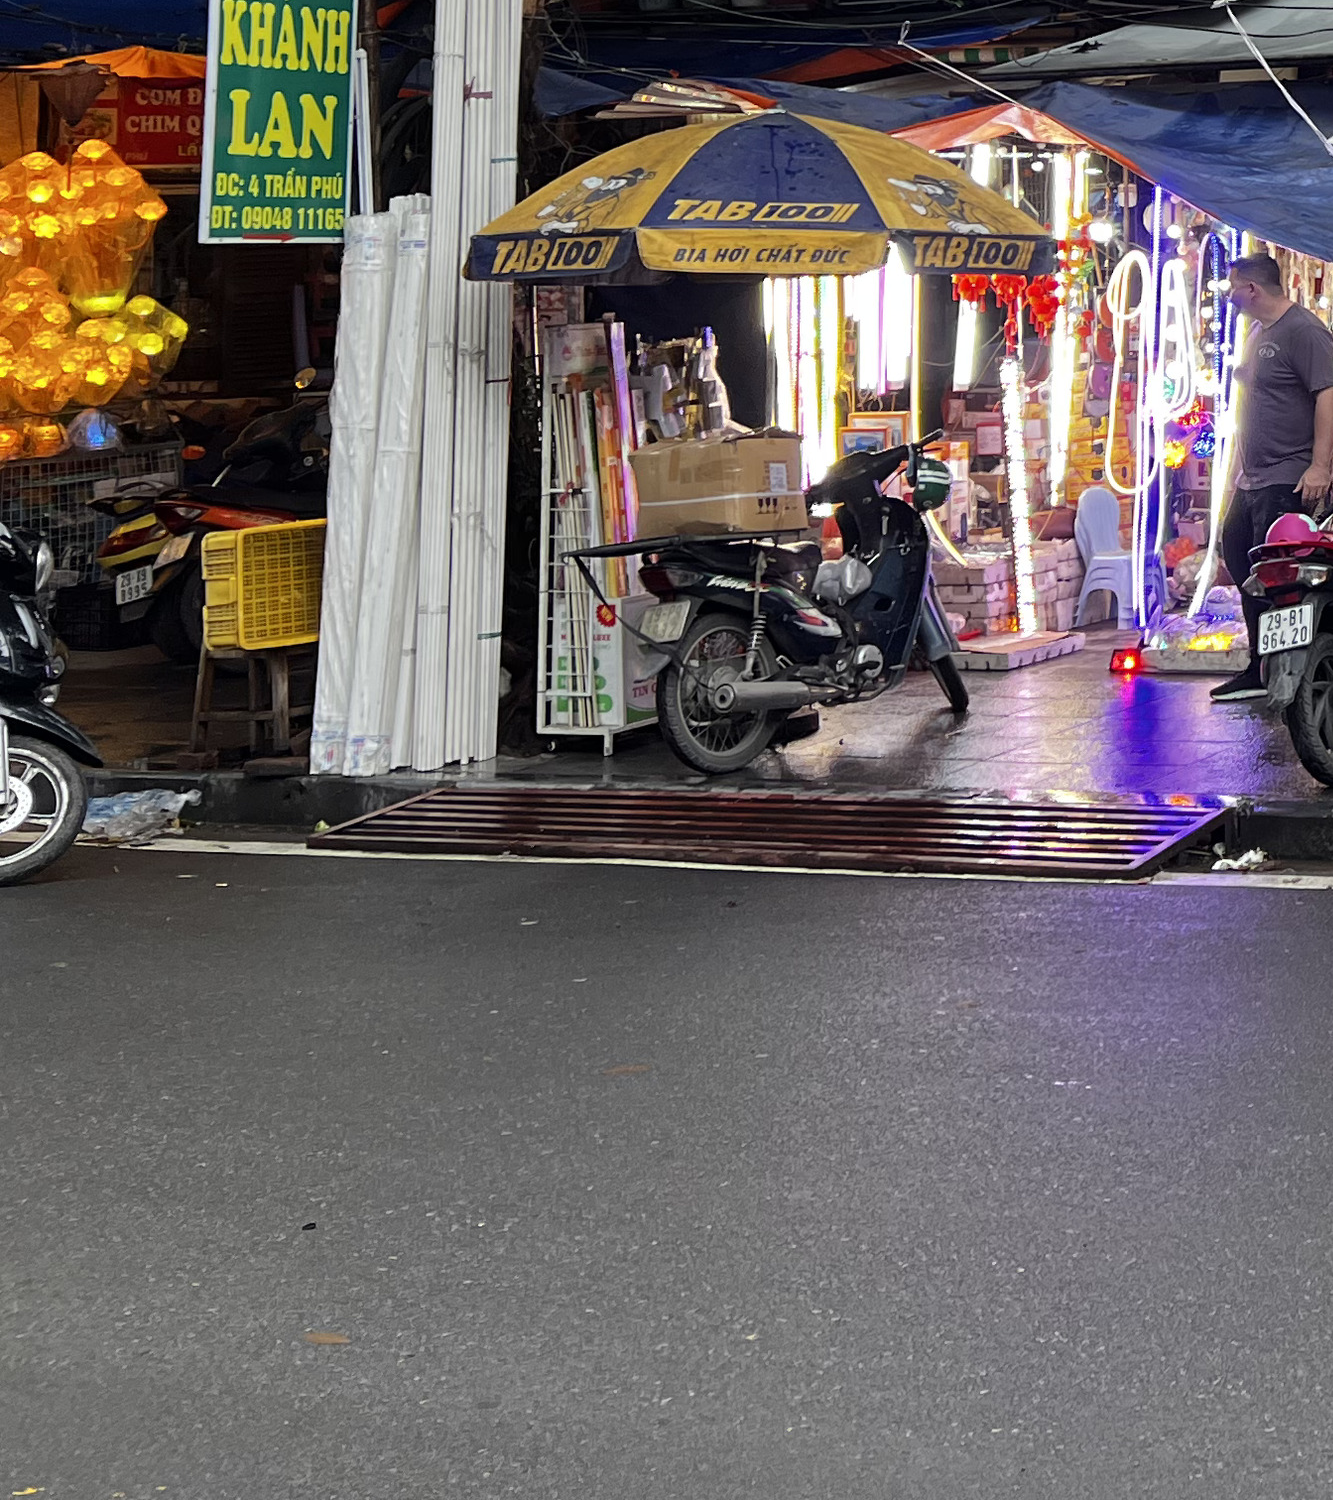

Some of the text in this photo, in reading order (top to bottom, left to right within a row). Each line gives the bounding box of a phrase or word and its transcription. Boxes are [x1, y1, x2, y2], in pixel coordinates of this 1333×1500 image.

[125, 115, 180, 133] CHIM
[227, 88, 338, 160] LAN
[215, 172, 244, 197] ĐC:
[248, 174, 259, 198] 4
[311, 172, 343, 199] PHÚ
[211, 205, 344, 230] ĐT: 09048 11165
[667, 199, 837, 222] TAB100
[490, 236, 604, 275] TAB100
[673, 239, 852, 265] BIA HƠI CHẤT ĐỨC
[912, 235, 1020, 269] TAB100
[1266, 607, 1304, 631] 29-B1
[1262, 625, 1308, 651] 964.20
